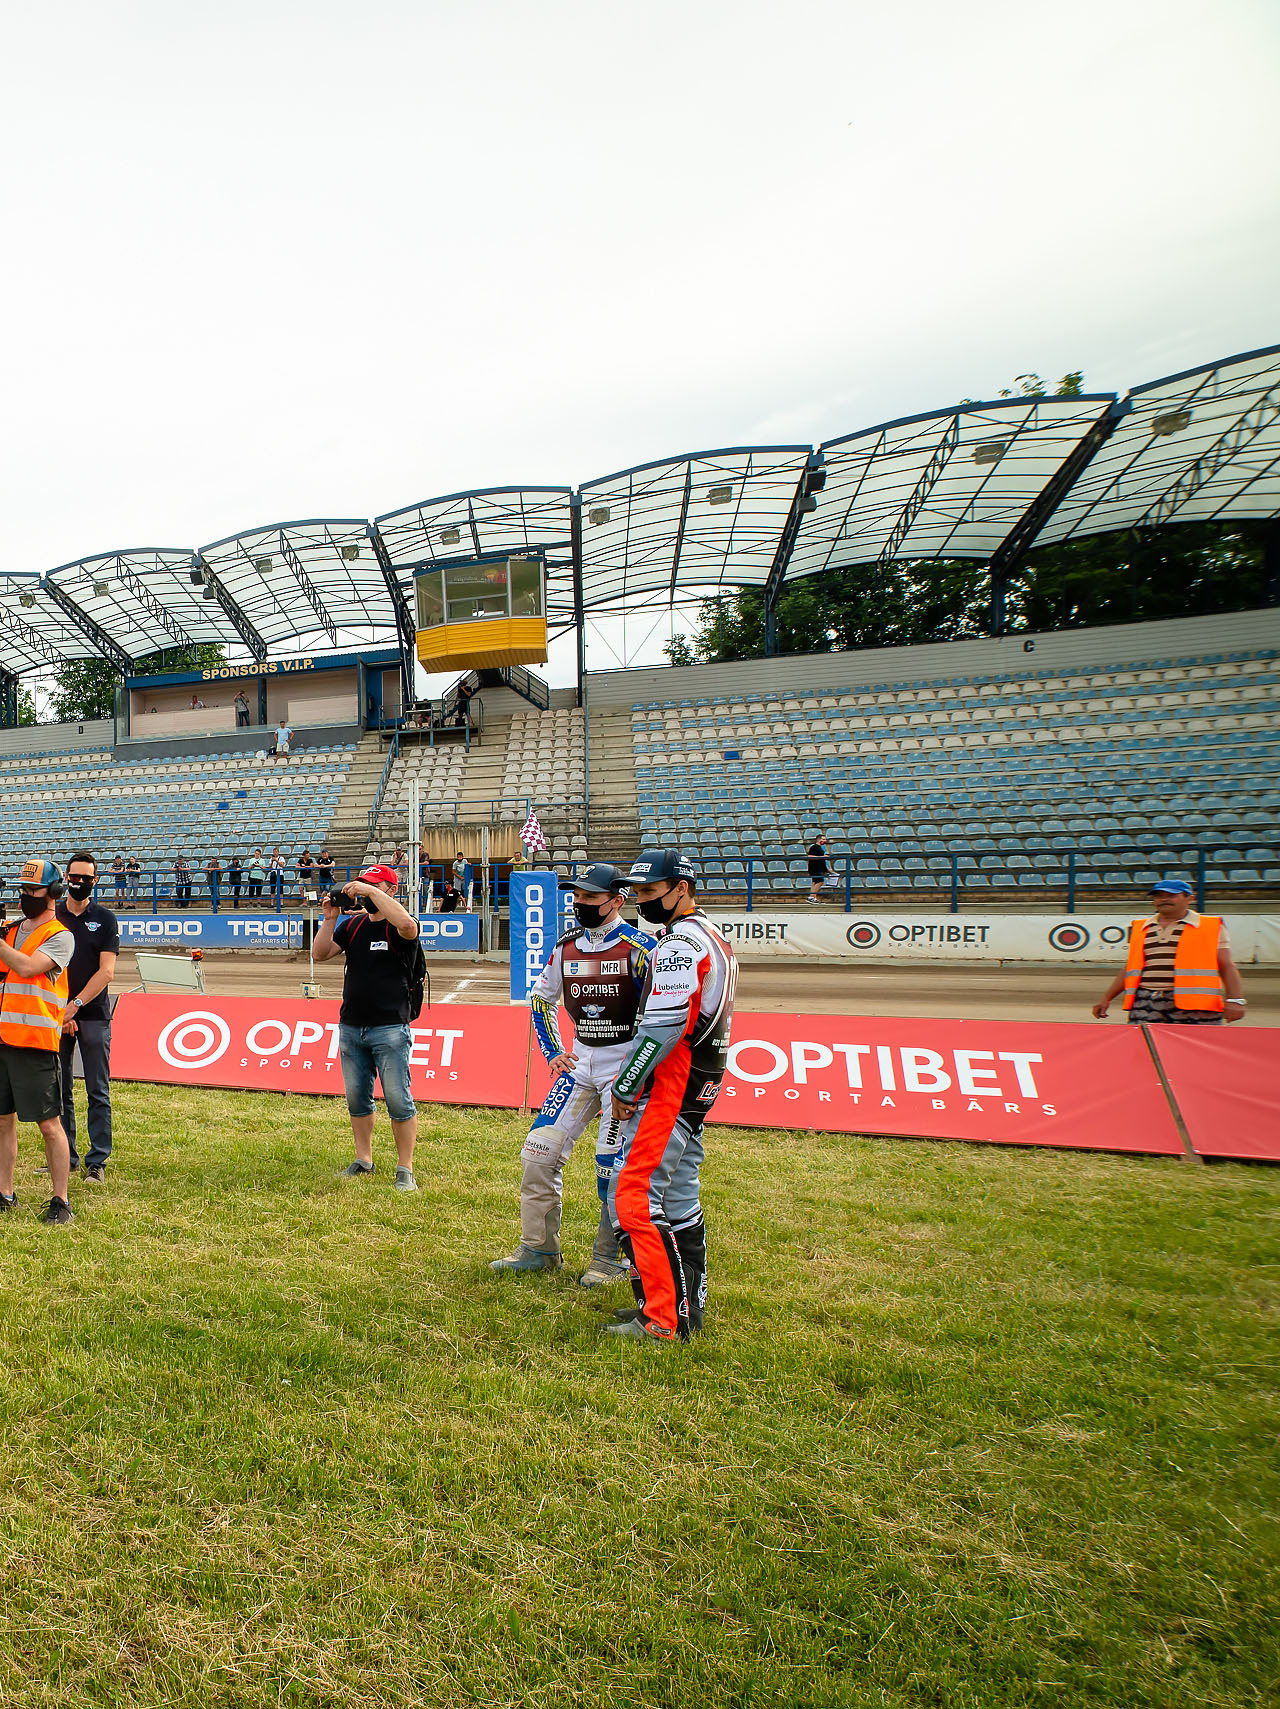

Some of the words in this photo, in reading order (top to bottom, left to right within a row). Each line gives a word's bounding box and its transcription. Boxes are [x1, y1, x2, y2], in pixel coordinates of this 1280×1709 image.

[202, 662, 278, 680] SPONSORS
[282, 658, 315, 672] V.I.P.
[117, 920, 203, 937] TRODO
[525, 884, 544, 989] TRODO
[888, 924, 991, 943] OPTIBET
[601, 963, 619, 973] MFR
[582, 984, 620, 994] OPTIBET
[245, 1019, 464, 1067] OPTET
[239, 1058, 334, 1072] SPORT
[618, 1041, 657, 1093] BOGDANKA
[726, 1039, 1045, 1099] OPTIBET
[725, 1085, 897, 1108] SPORTA
[931, 1097, 1058, 1116] BĀRS
